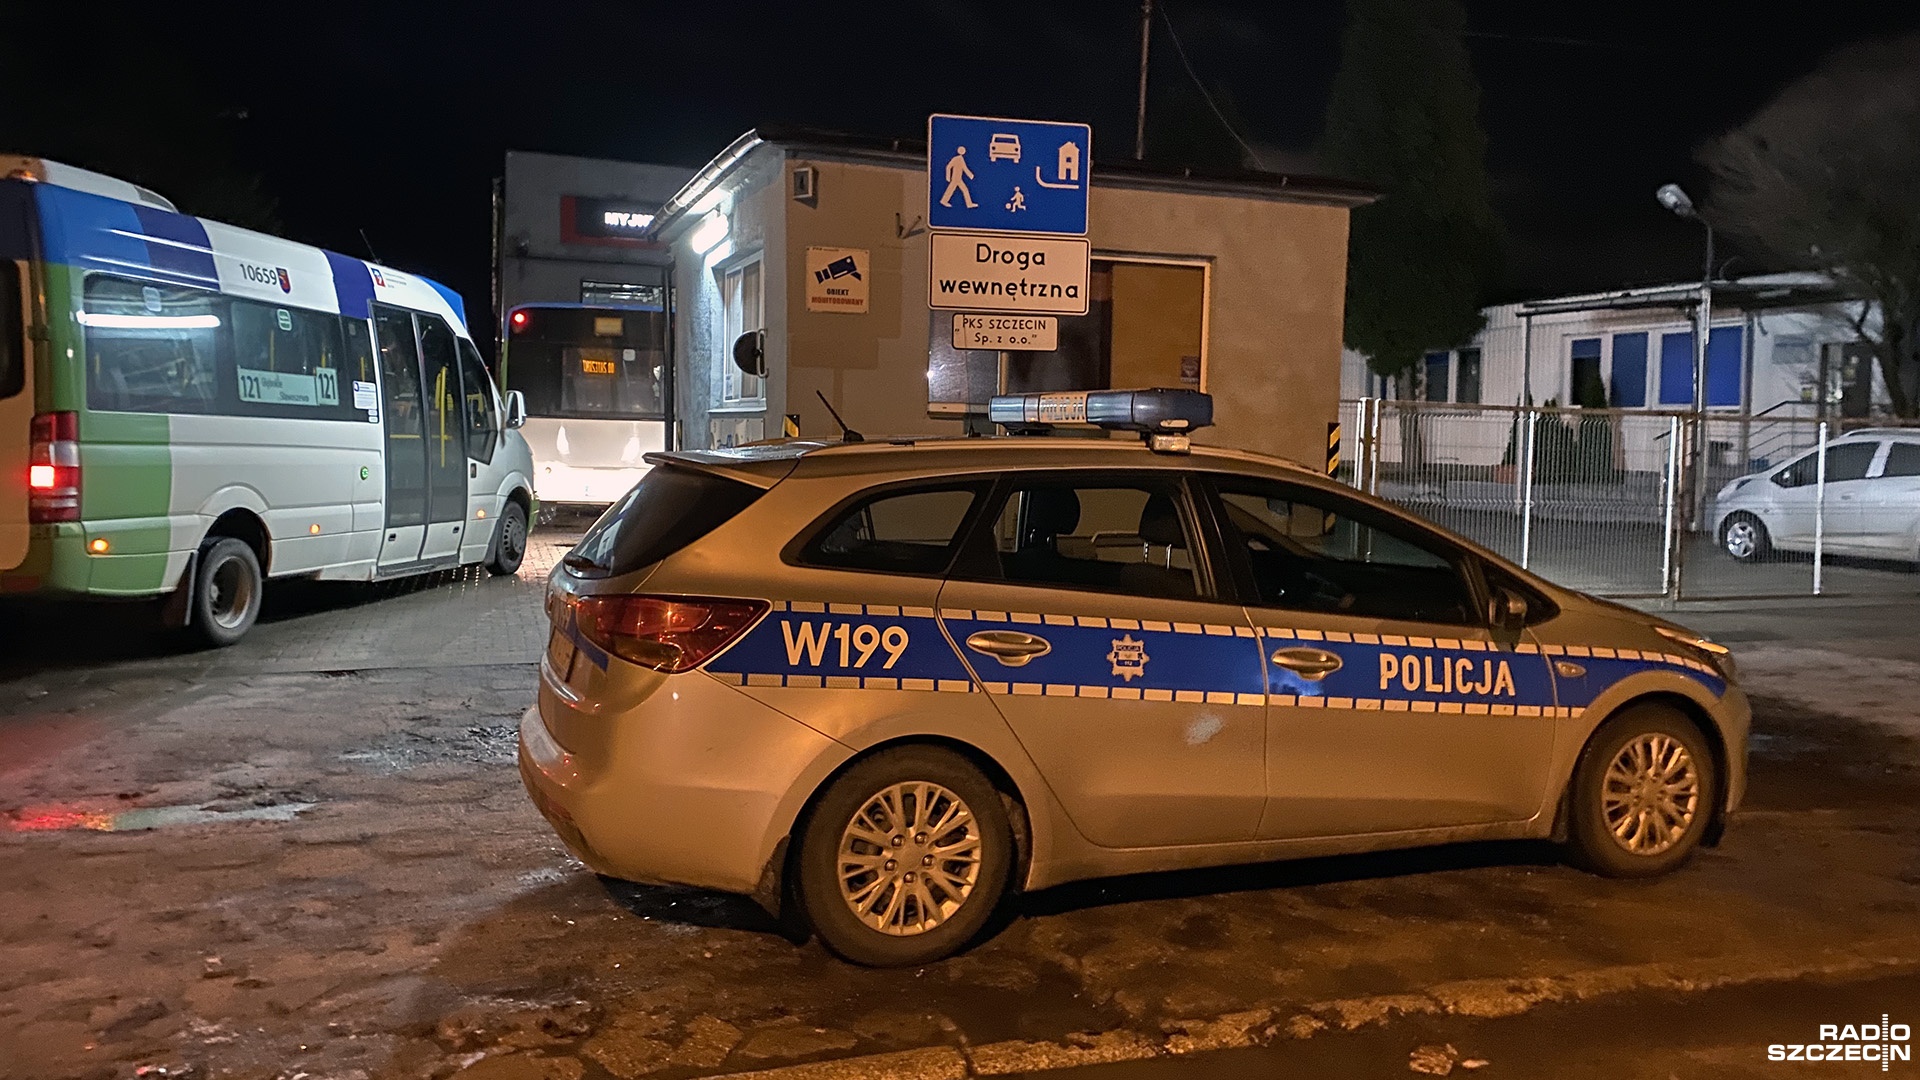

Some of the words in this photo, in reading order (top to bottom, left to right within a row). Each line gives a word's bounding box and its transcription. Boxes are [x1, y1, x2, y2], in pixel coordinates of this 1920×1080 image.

[975, 243, 1046, 270] Droga
[239, 263, 277, 285] 10659
[939, 278, 1080, 301] wewnętrzna
[988, 319, 1047, 331] SZCZECIN
[974, 332, 993, 346] Sp.
[996, 336, 1003, 344] z
[240, 375, 261, 399] 121
[318, 373, 336, 399] 121
[780, 620, 910, 668] W199
[1379, 653, 1516, 696] POLICJA
